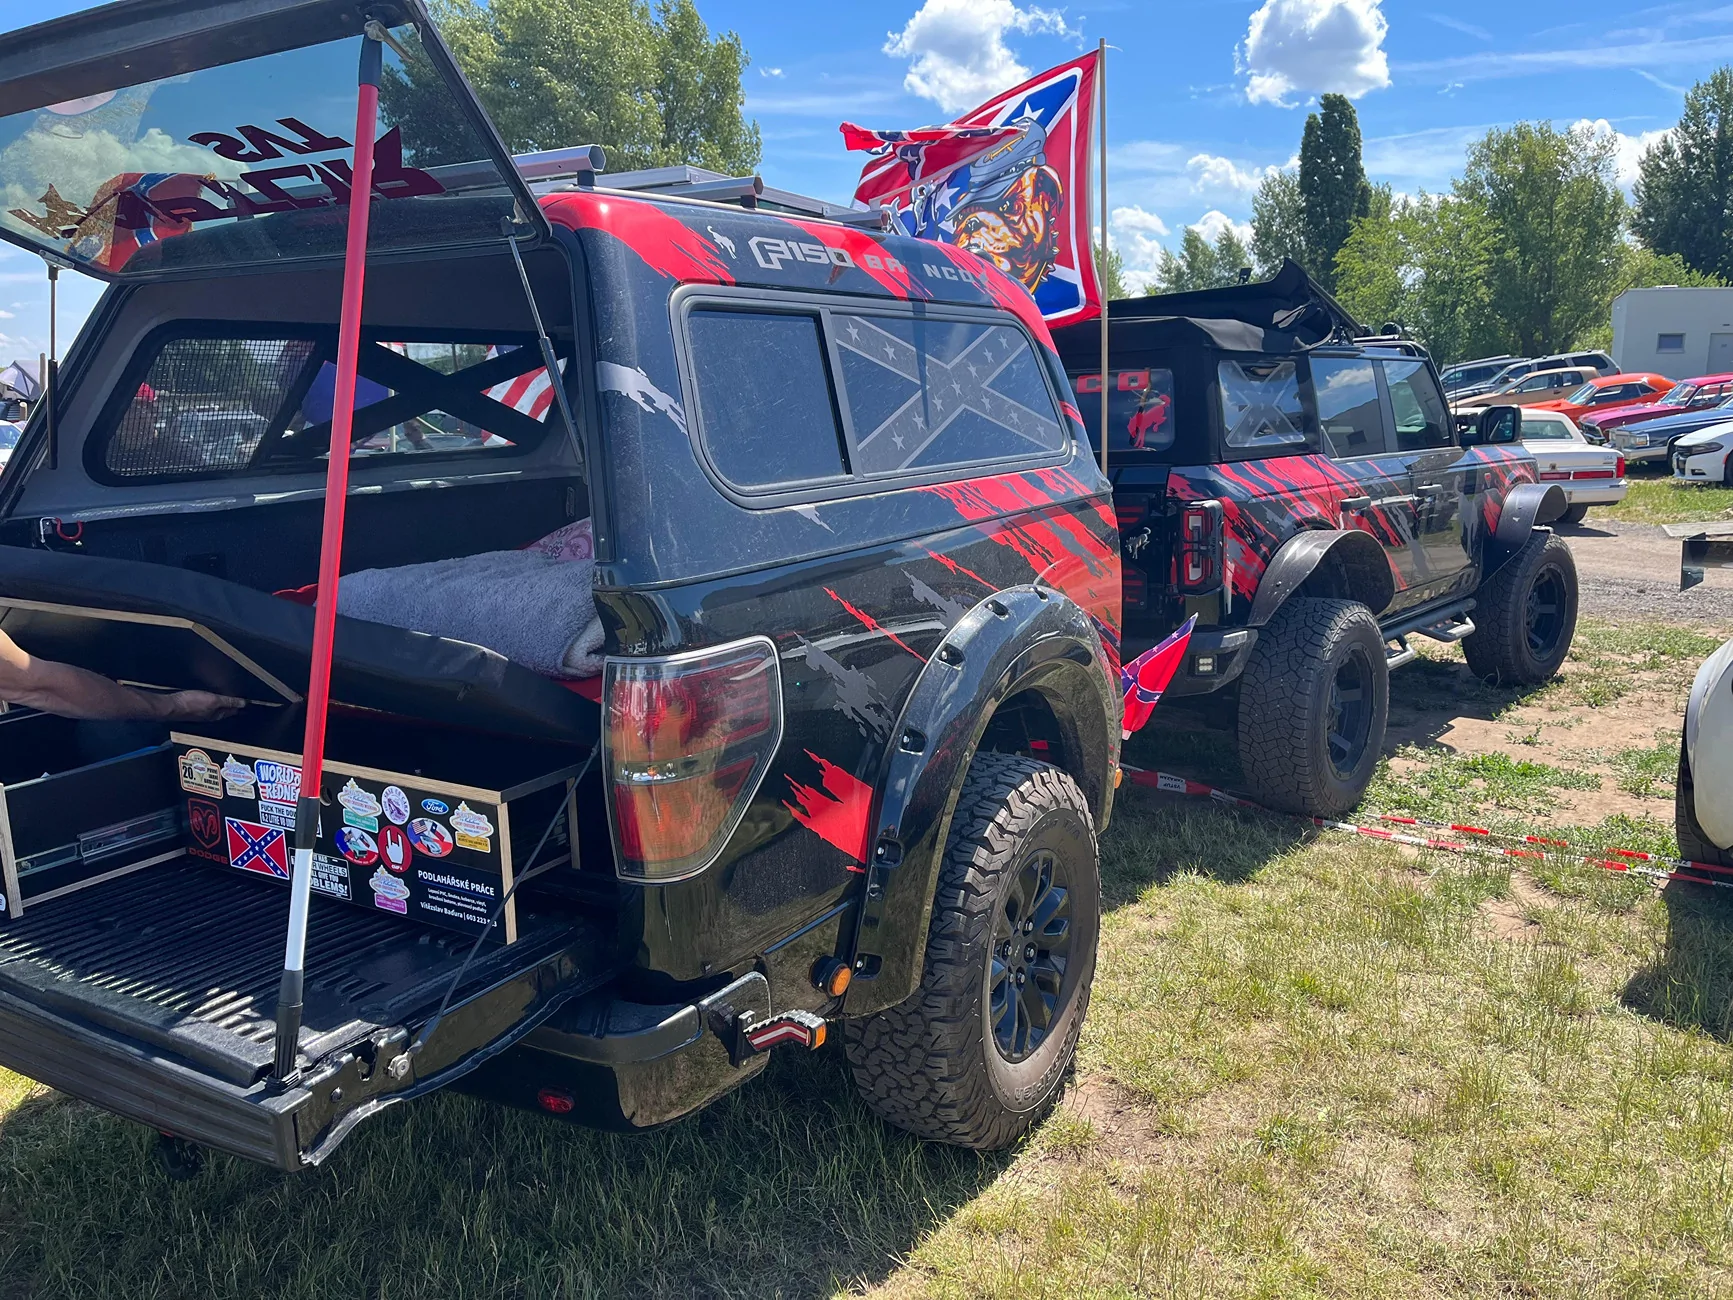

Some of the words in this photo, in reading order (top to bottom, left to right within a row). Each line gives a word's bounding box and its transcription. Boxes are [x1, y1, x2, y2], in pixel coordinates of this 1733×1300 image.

[749, 236, 853, 270] F150
[182, 765, 196, 781] 20.
[260, 764, 294, 785] WORLD
[261, 804, 274, 813] FUCK
[275, 806, 285, 815] THE
[189, 847, 229, 865] DODGE
[317, 863, 347, 876] WHEELS
[418, 870, 470, 890] PODLAHÁŘSKÉ
[471, 883, 495, 896] PRÁCE
